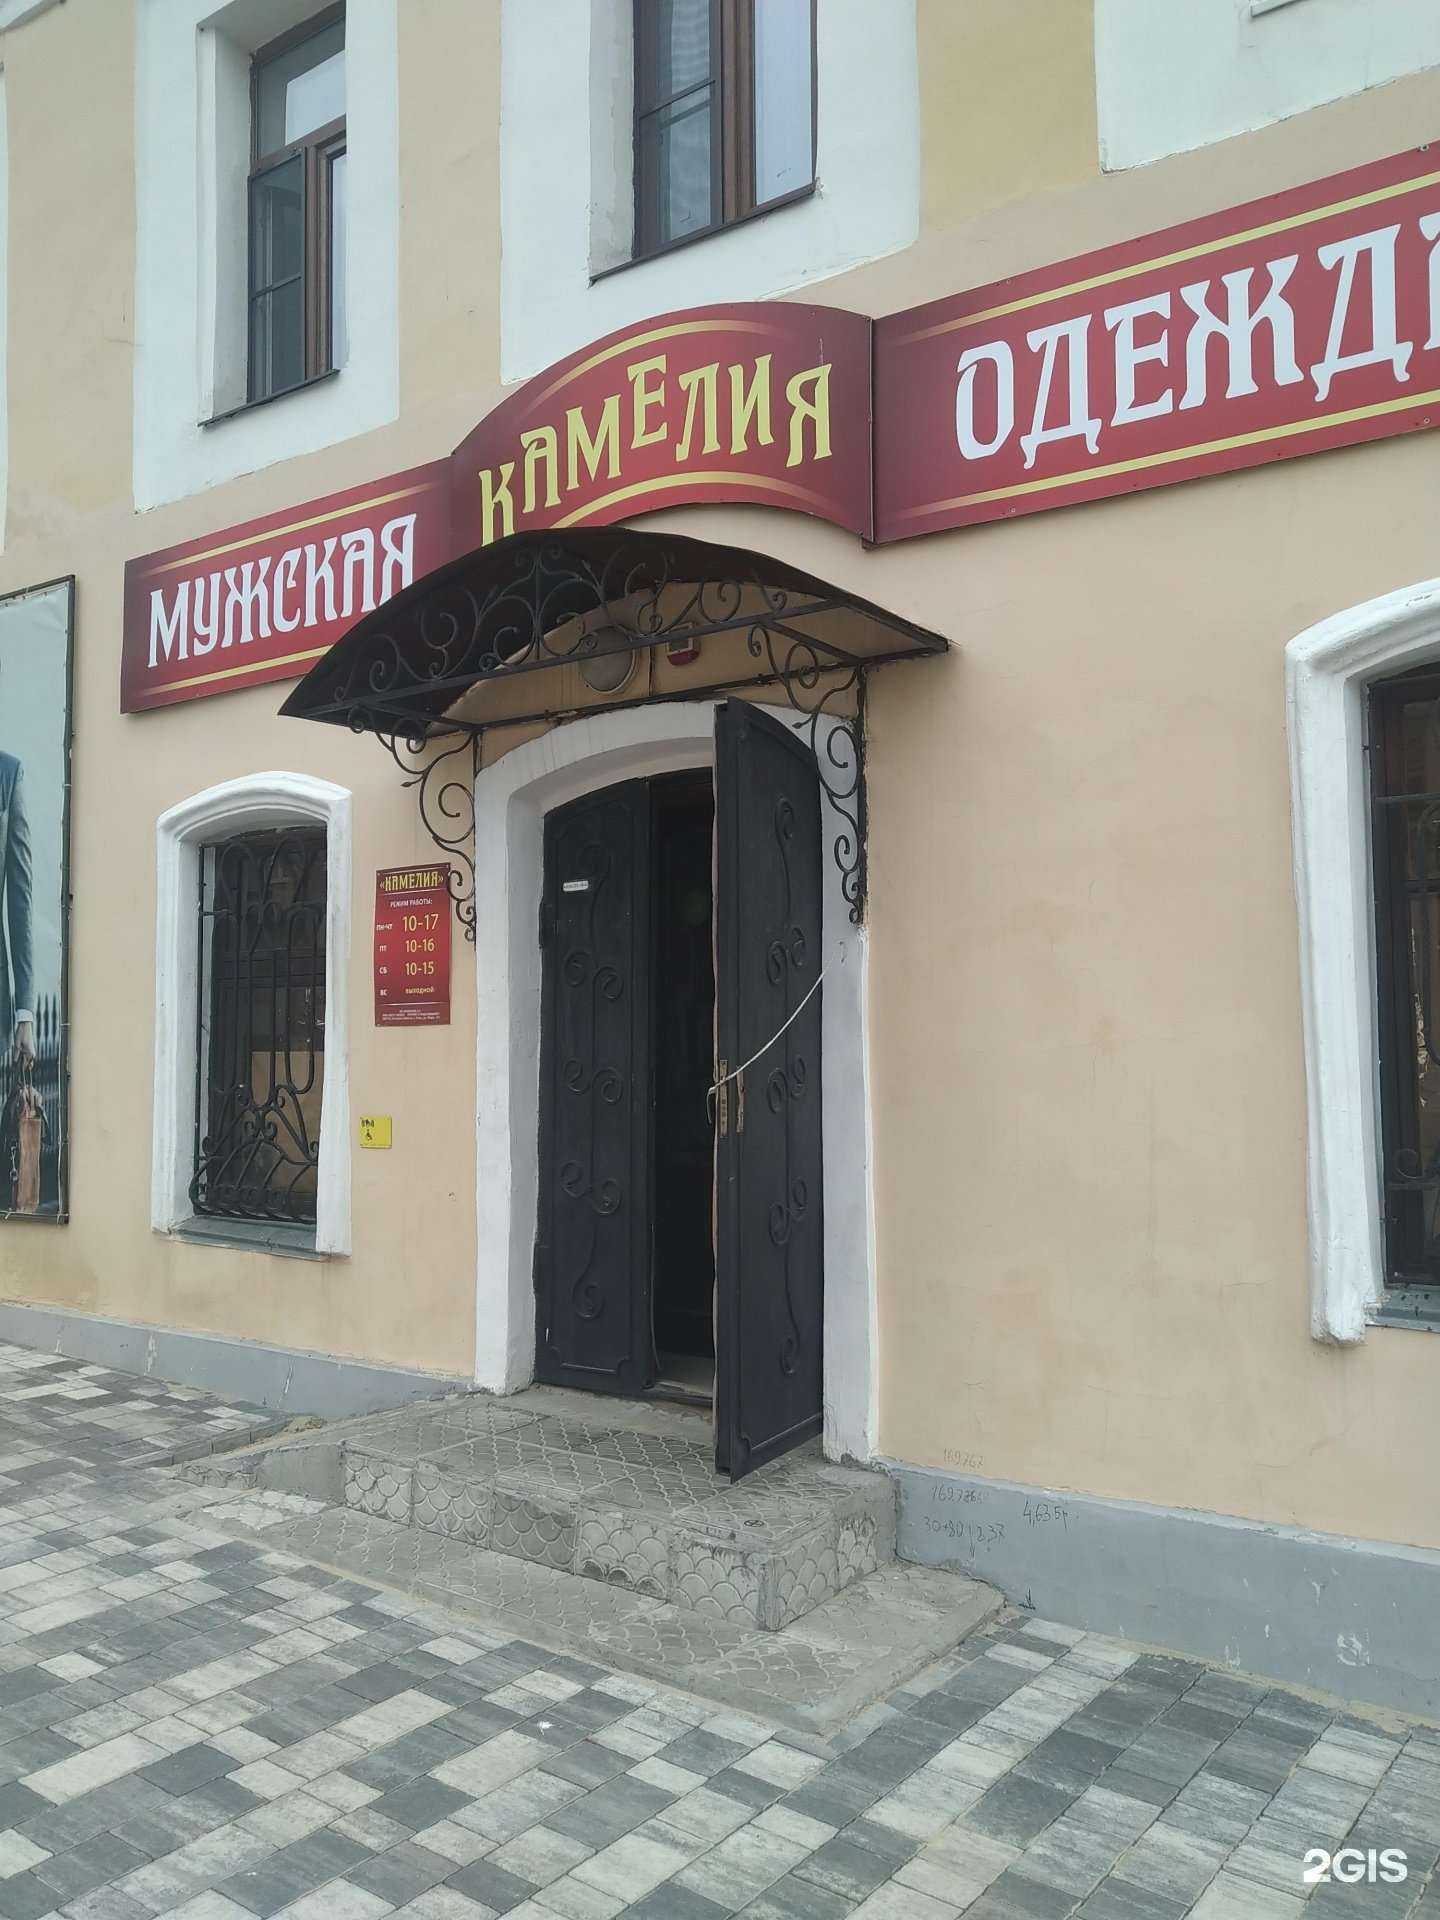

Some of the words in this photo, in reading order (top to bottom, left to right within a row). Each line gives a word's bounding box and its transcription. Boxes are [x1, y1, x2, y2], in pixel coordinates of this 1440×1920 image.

[479, 353, 832, 547] КАМЕЛИЯ
[147, 513, 417, 668] МУЖСКАЯ
[402, 913, 439, 932] 10-17
[405, 938, 435, 953] 10-16
[405, 961, 435, 976] 10-15
